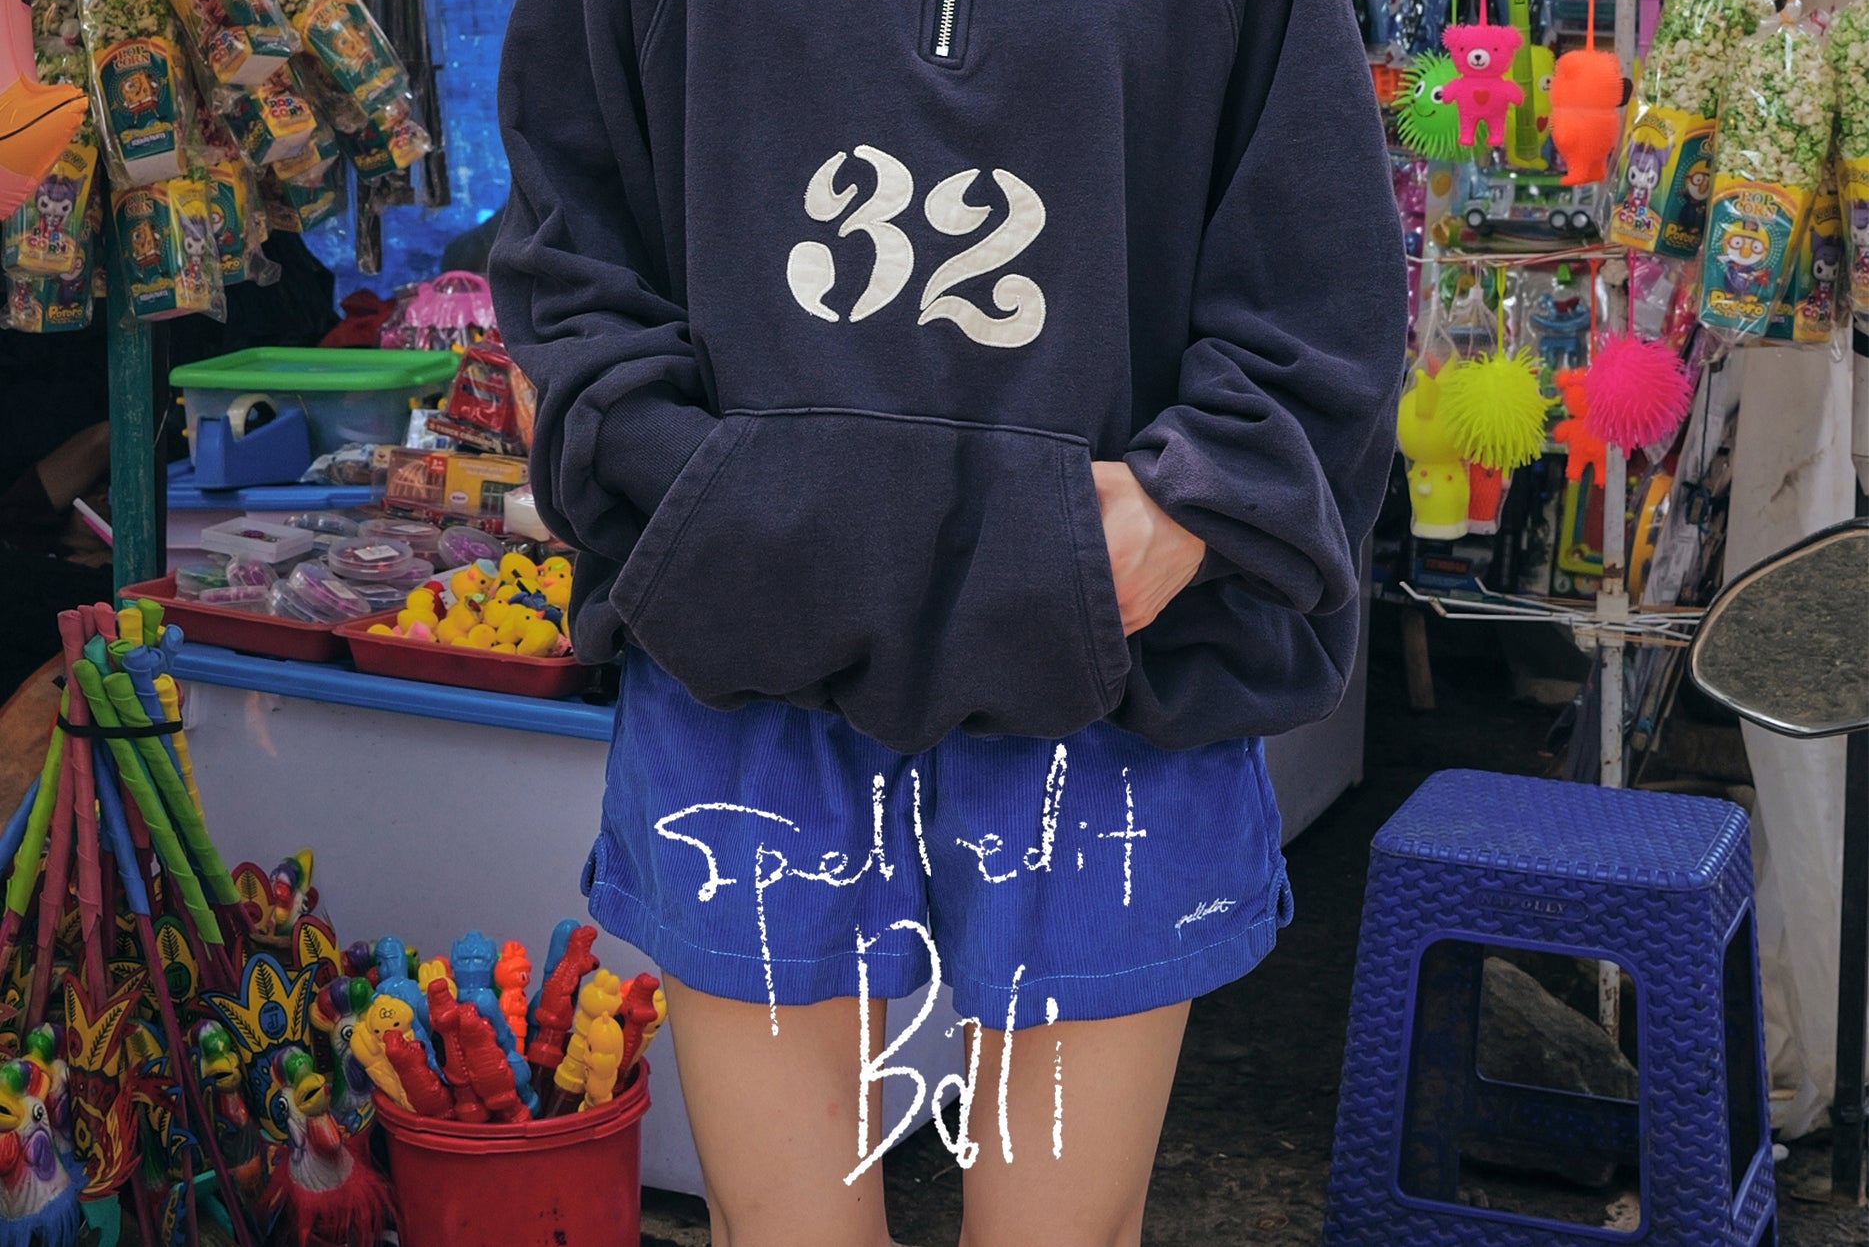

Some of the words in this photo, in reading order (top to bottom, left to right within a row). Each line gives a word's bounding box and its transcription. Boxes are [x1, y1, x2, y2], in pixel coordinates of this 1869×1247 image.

[115, 54, 150, 69] CORN
[116, 46, 146, 61] POP
[269, 98, 293, 108] POP
[1740, 190, 1775, 204] POP
[1623, 201, 1647, 217] POP
[1733, 200, 1777, 217] CORN
[1619, 211, 1653, 231] CORN
[28, 237, 67, 253] CORN
[787, 144, 1046, 348] 32
[1710, 289, 1766, 317] Pororo
